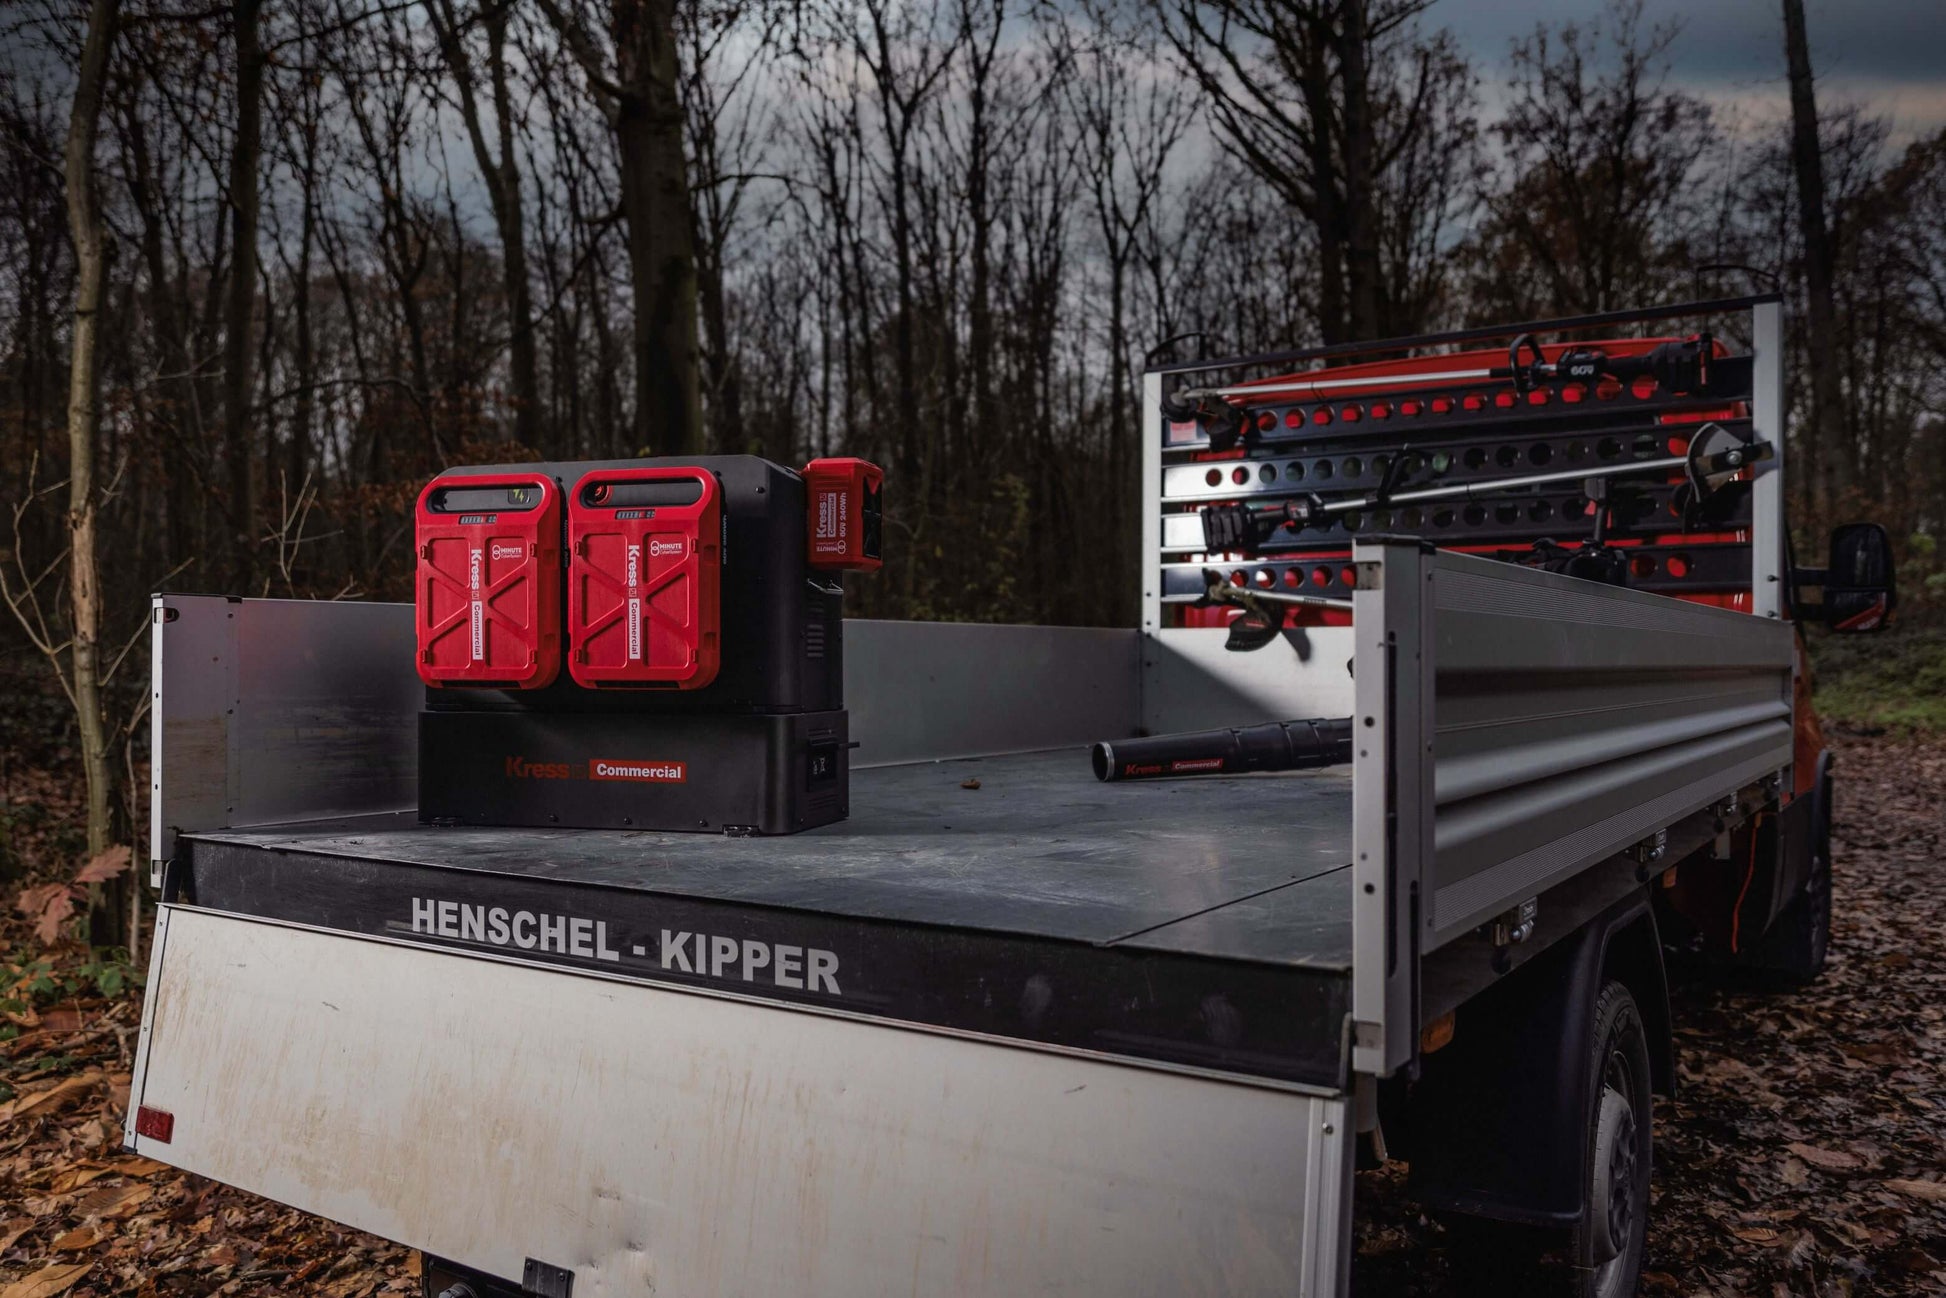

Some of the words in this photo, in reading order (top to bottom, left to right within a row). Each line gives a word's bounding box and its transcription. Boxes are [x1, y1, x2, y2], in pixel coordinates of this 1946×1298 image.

[1570, 364, 1595, 376] 60V
[815, 501, 827, 538] Kress
[471, 549, 482, 590] Kress
[628, 545, 640, 587] Kress
[505, 755, 570, 780] Kress
[596, 762, 682, 779] Commercial
[1175, 760, 1220, 770] Commercial
[412, 896, 620, 962] HENSCHEL
[660, 928, 841, 995] KIPPER
